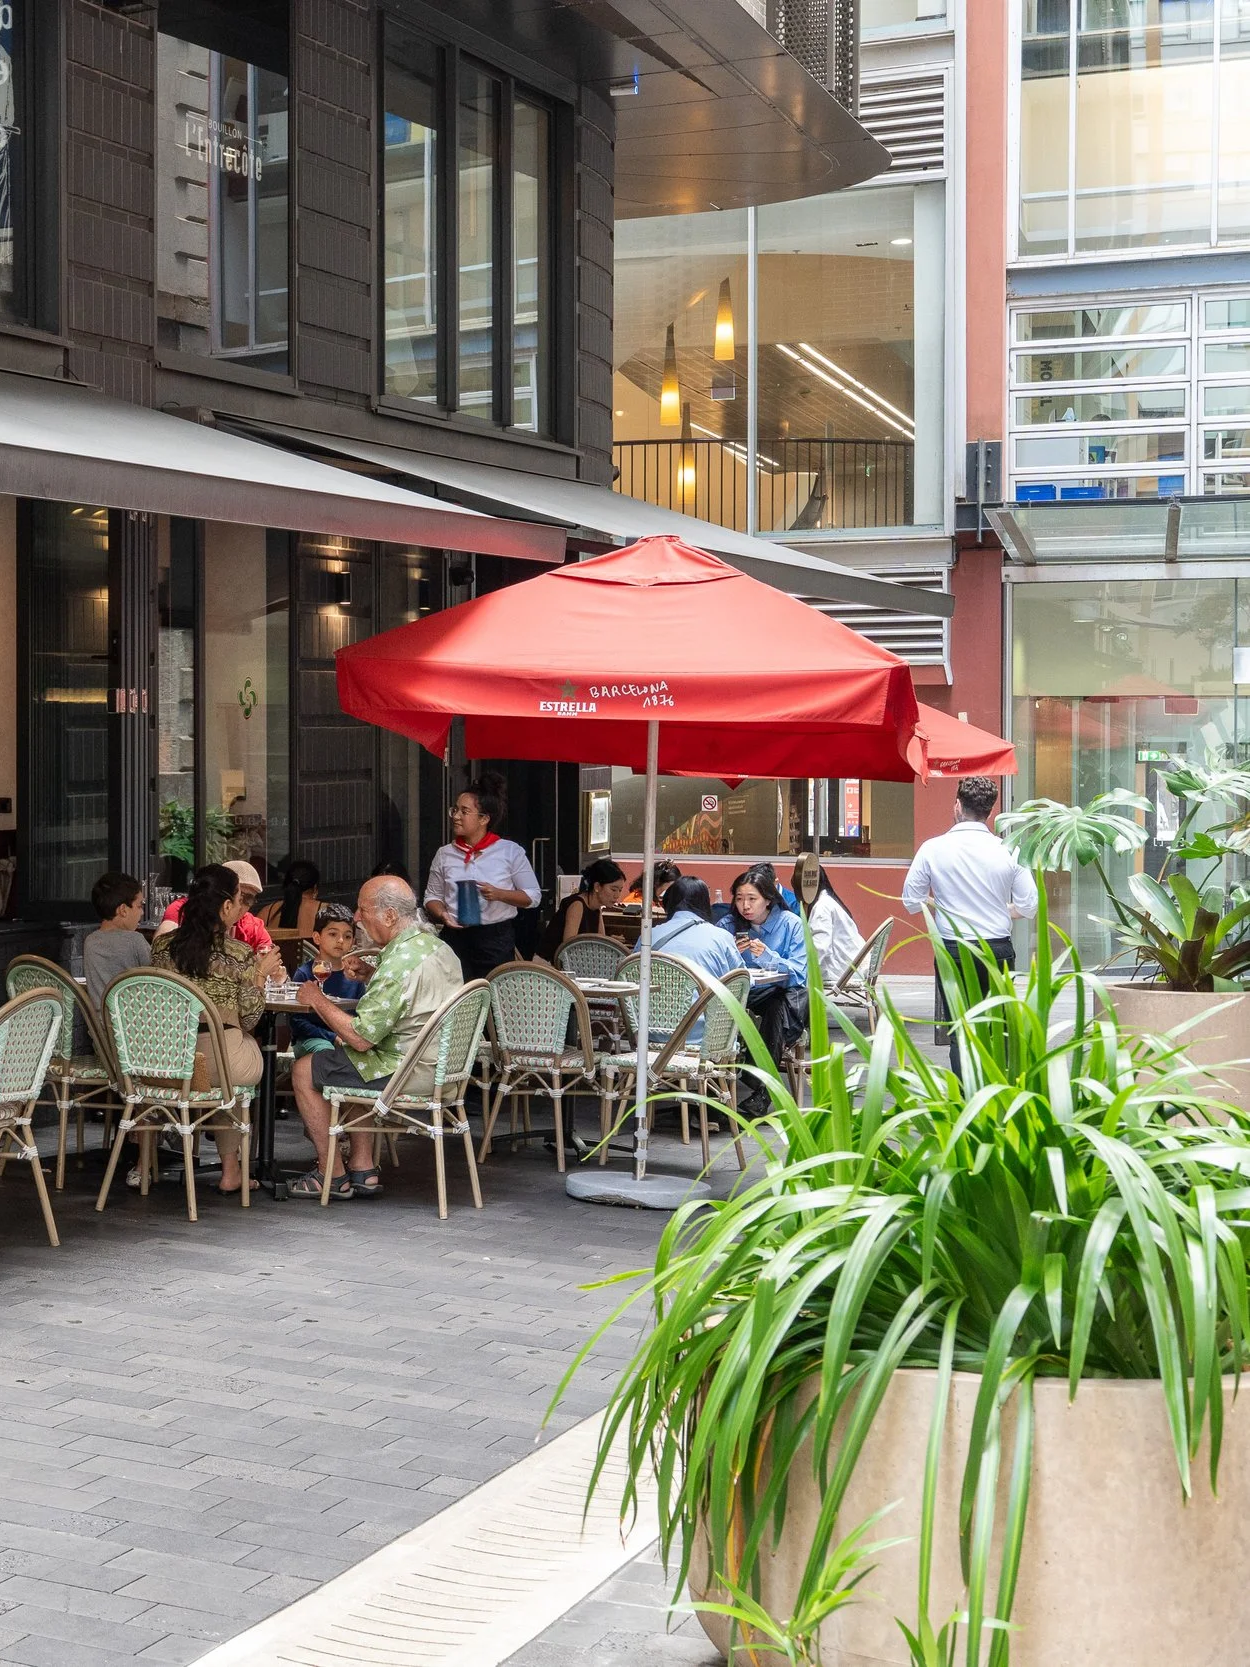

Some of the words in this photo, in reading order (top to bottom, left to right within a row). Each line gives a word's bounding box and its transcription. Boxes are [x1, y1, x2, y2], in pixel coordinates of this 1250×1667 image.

[209, 118, 242, 139] BOUILLON
[589, 680, 668, 698] BARCELONA
[539, 701, 597, 713] ESTRELLA
[642, 694, 675, 708] 1876
